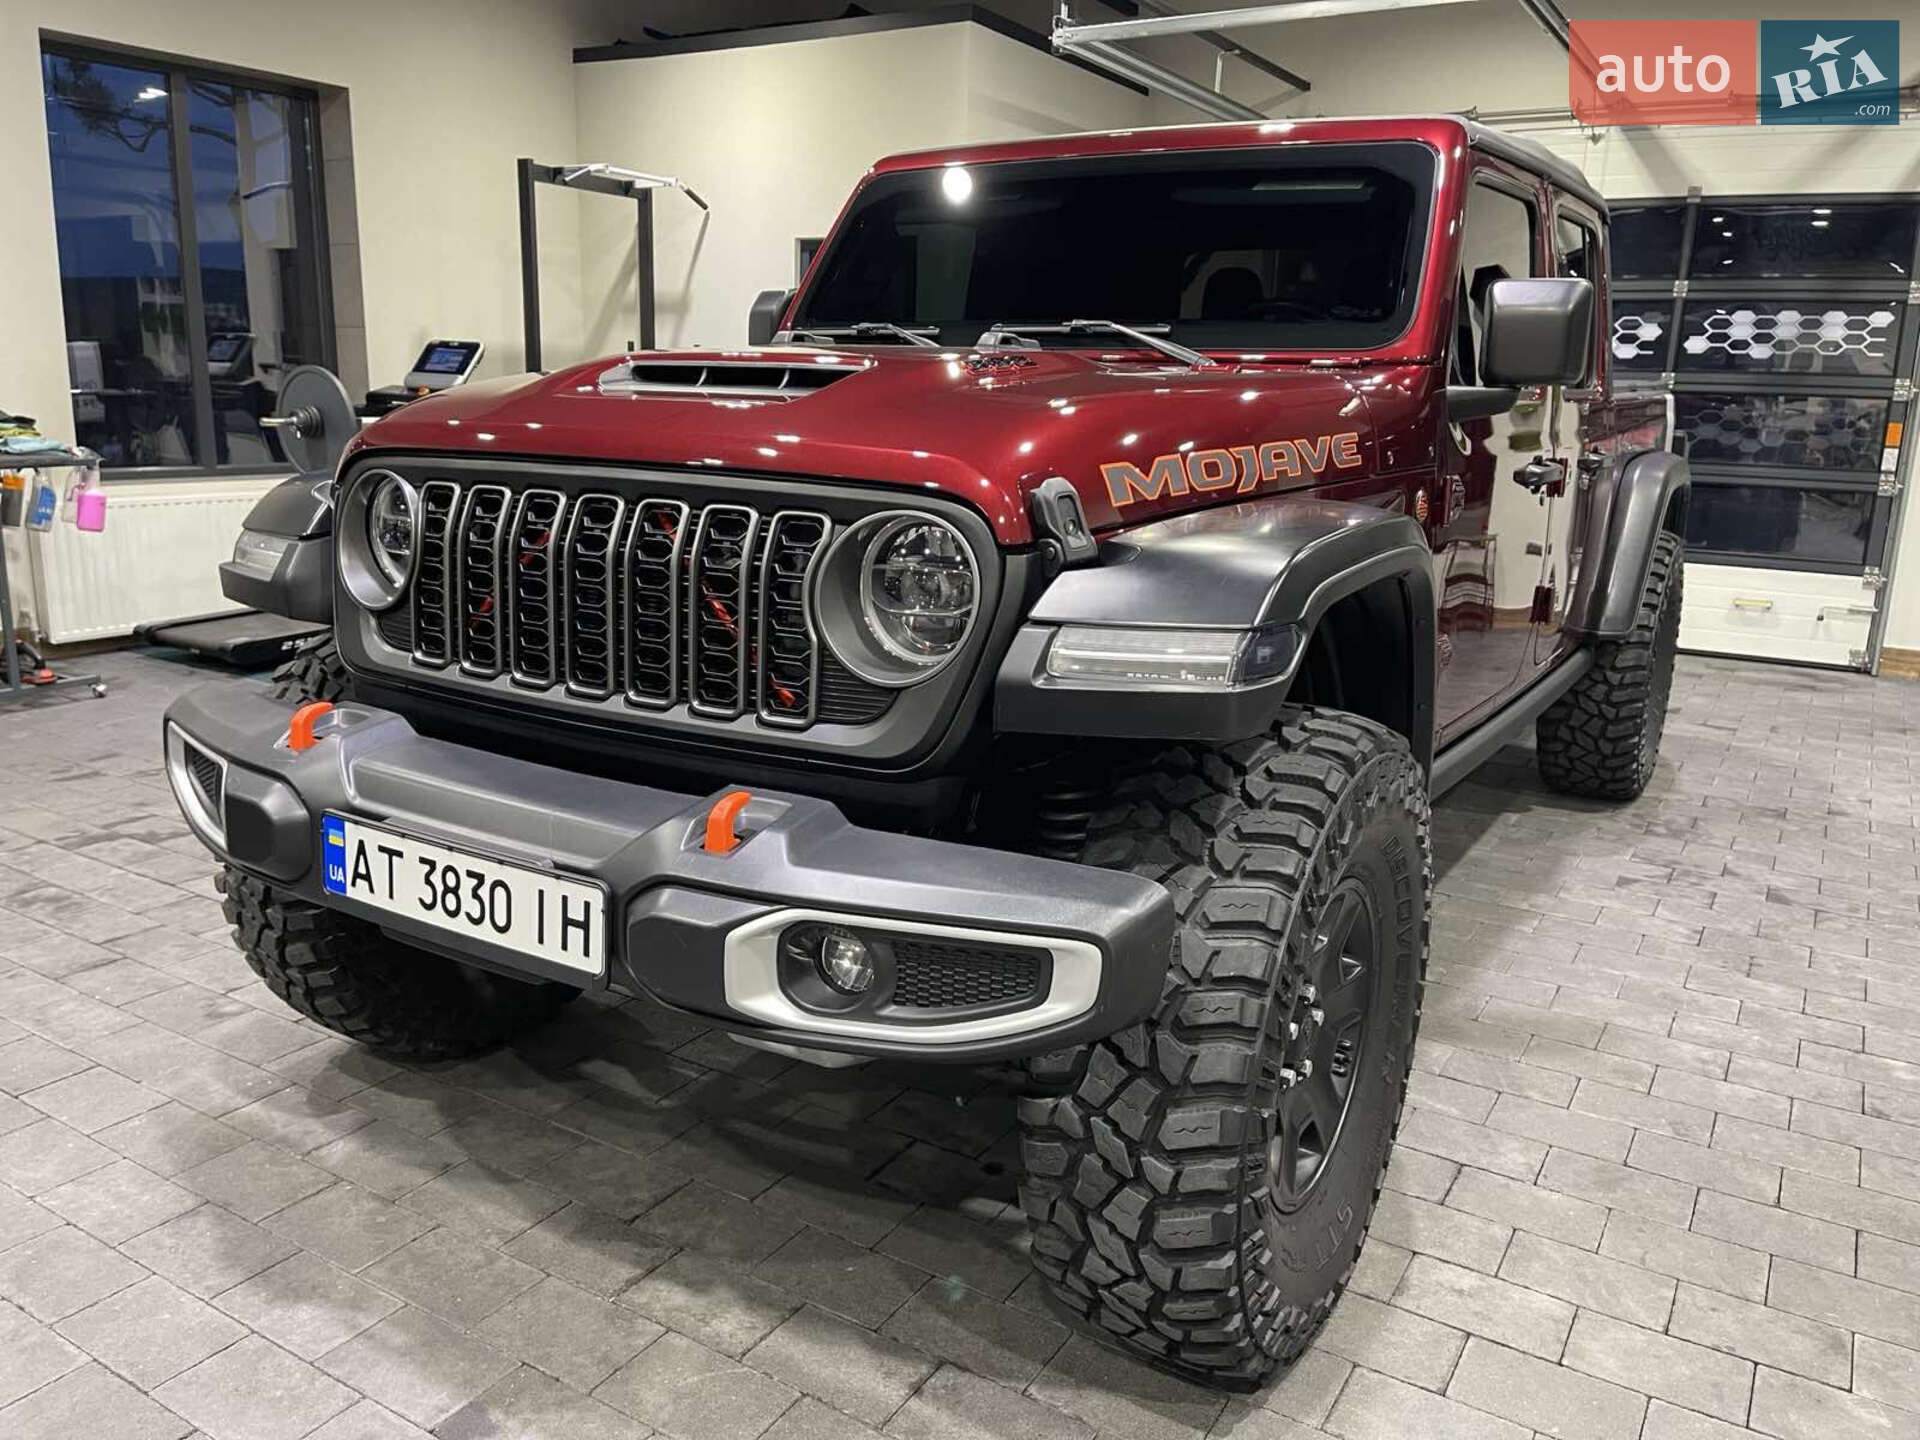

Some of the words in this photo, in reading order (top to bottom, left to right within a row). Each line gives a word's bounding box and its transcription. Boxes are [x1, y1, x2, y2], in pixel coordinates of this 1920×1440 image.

[1100, 432, 1362, 507] MOJAVE
[329, 865, 345, 884] UA
[351, 839, 404, 900] AT
[418, 856, 512, 934] 3830
[537, 888, 591, 958] IH
